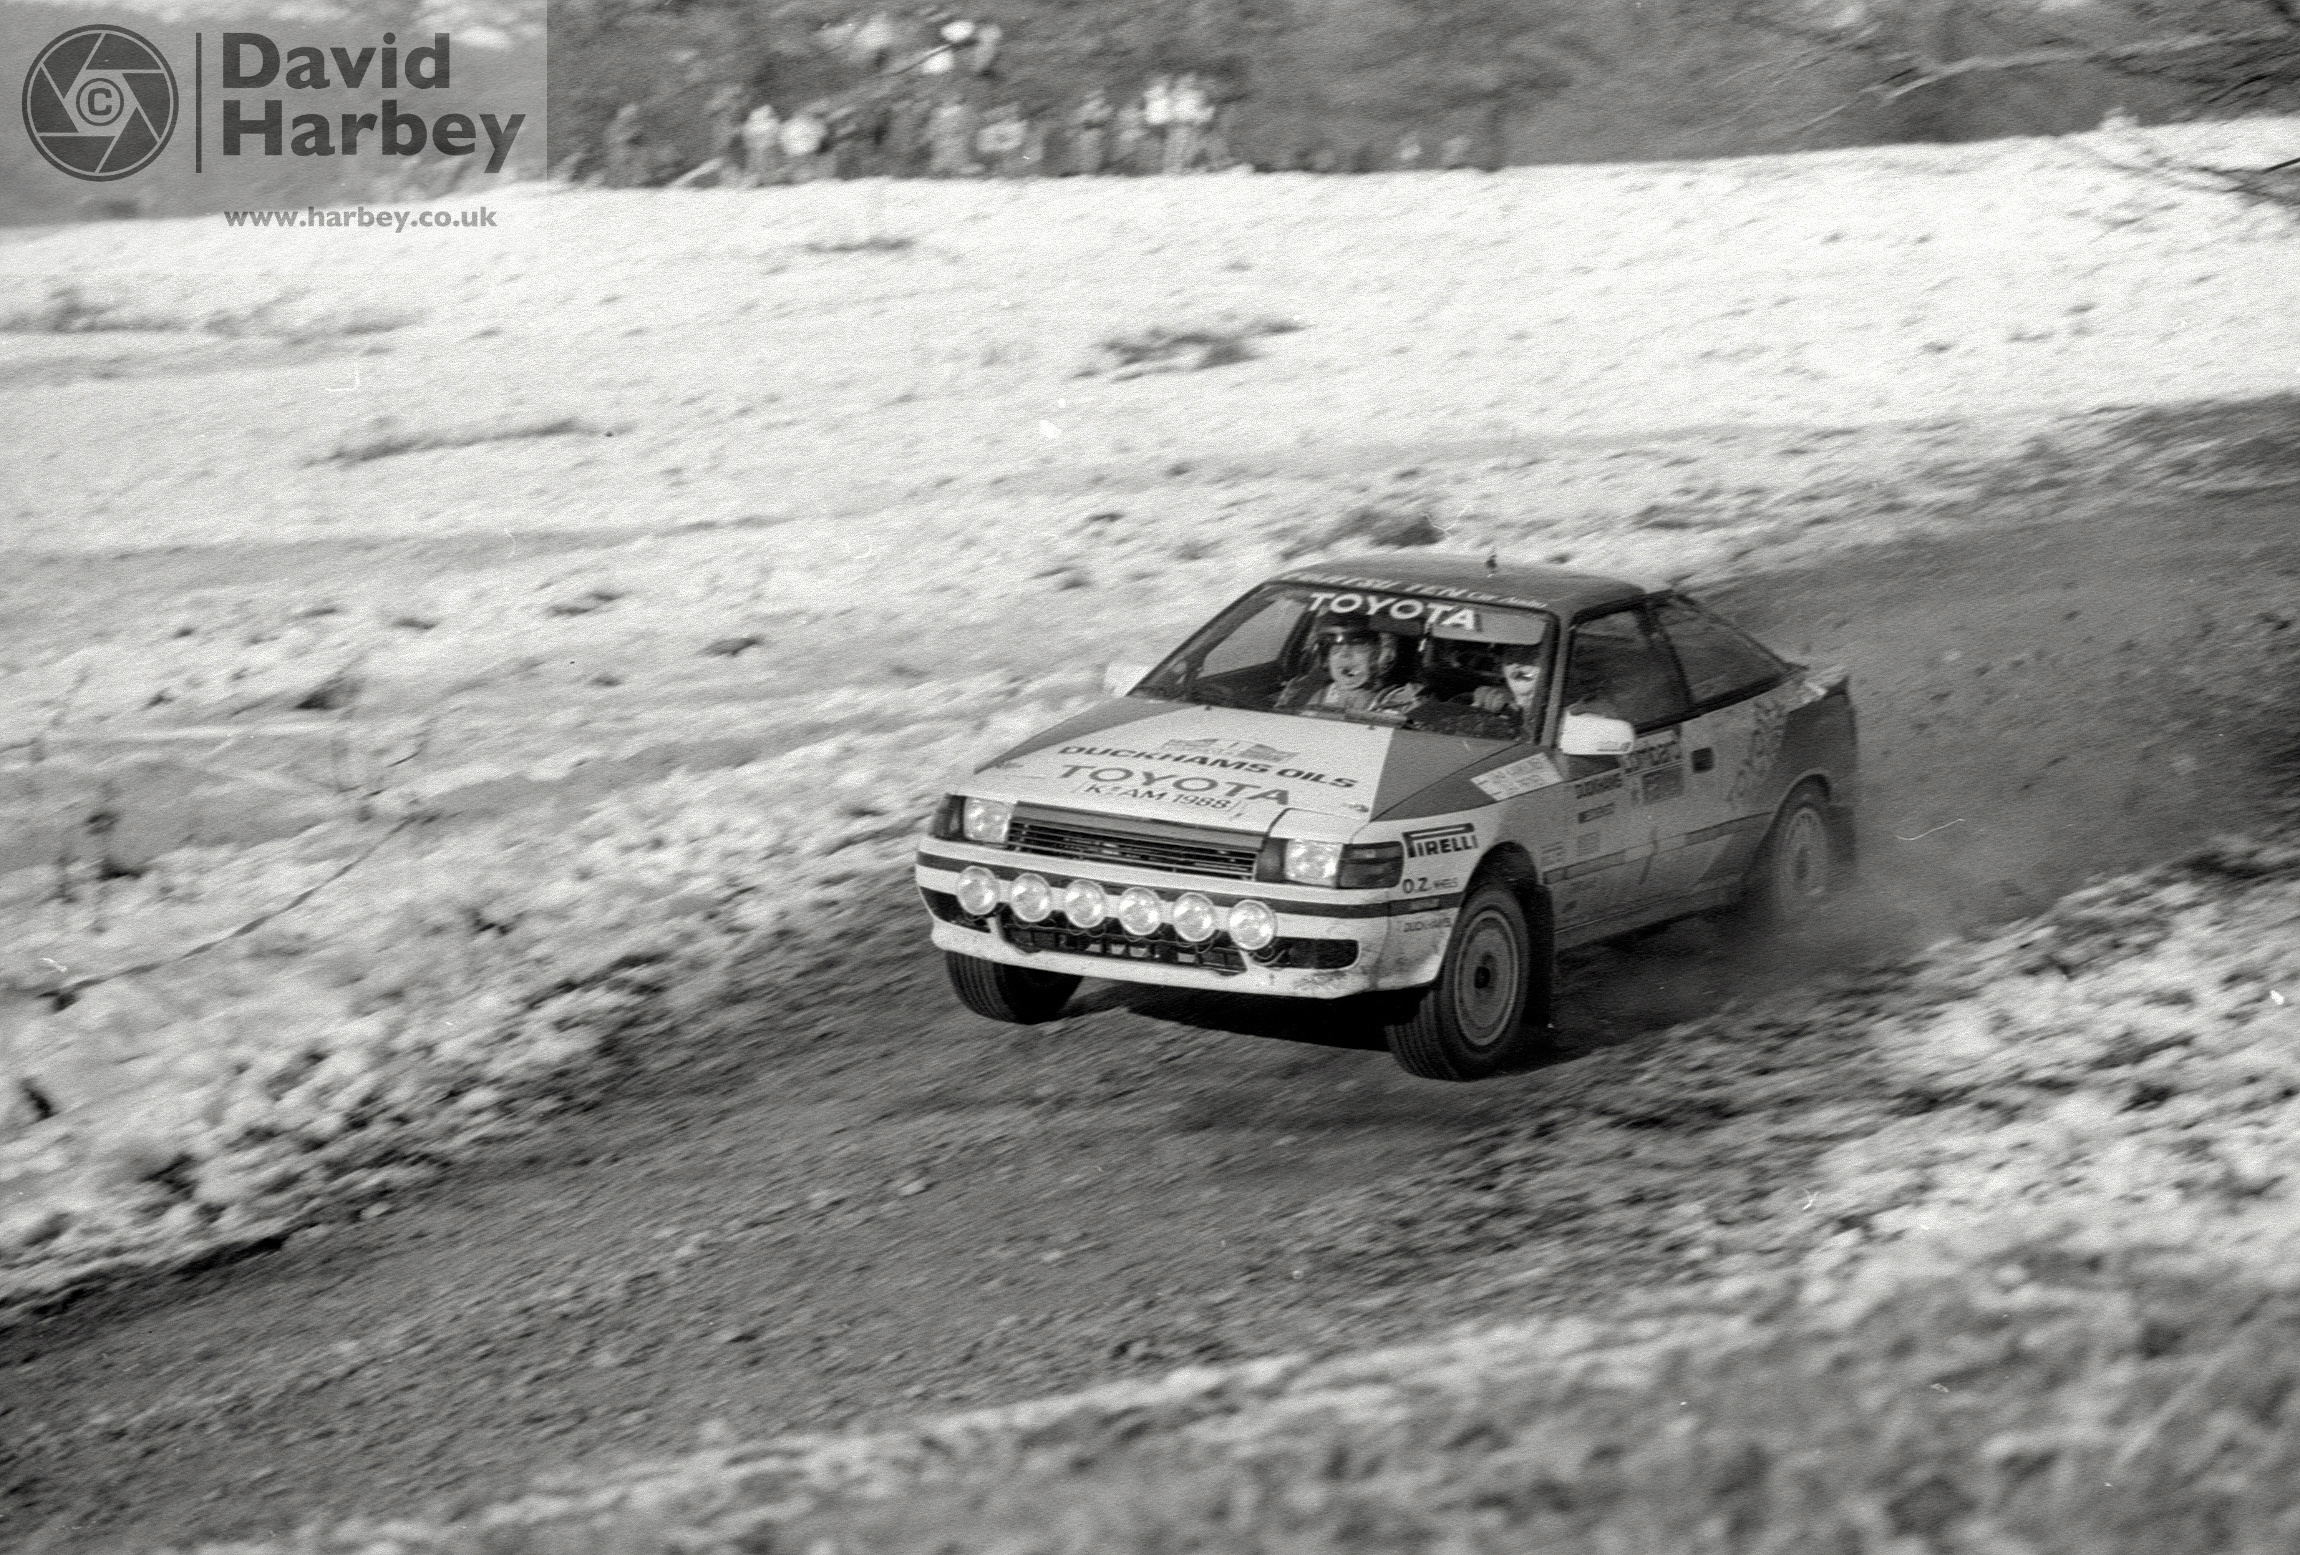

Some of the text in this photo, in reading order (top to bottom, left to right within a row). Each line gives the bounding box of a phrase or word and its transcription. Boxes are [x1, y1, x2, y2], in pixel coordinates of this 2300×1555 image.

[1308, 592, 1476, 632] TOYOTA
[1057, 746, 1273, 773] DUCKHAMS
[1276, 768, 1359, 789] OILS
[1059, 764, 1290, 806] TOYOTA
[1172, 792, 1233, 810] 1988
[1401, 822, 1479, 858] PIRELLI
